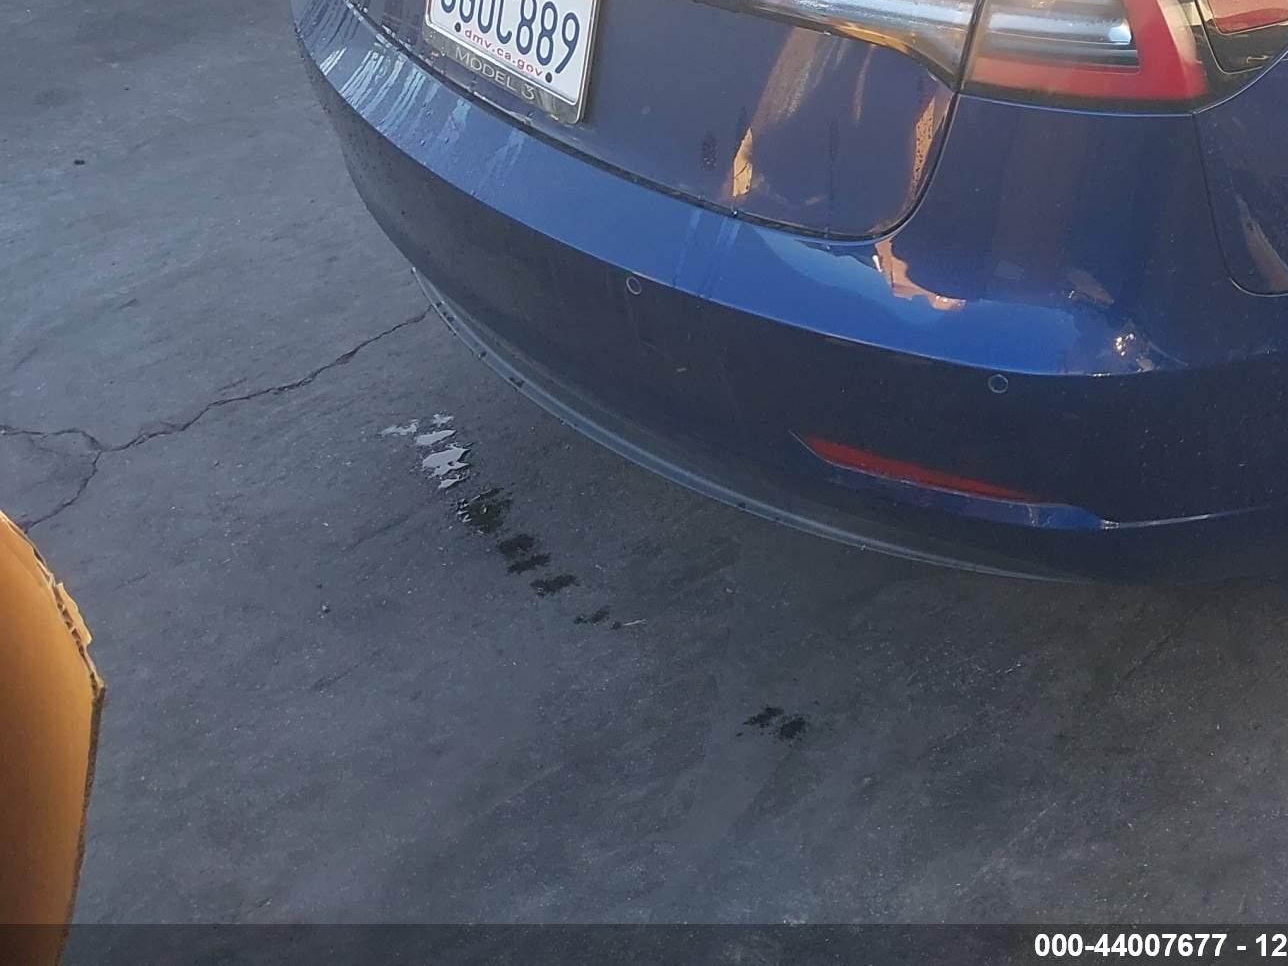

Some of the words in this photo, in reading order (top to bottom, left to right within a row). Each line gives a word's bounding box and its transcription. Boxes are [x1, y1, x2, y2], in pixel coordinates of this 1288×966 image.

[455, 46, 517, 92] MODEL
[521, 83, 536, 101] 3
[464, 28, 543, 77] dmv.ca.gov
